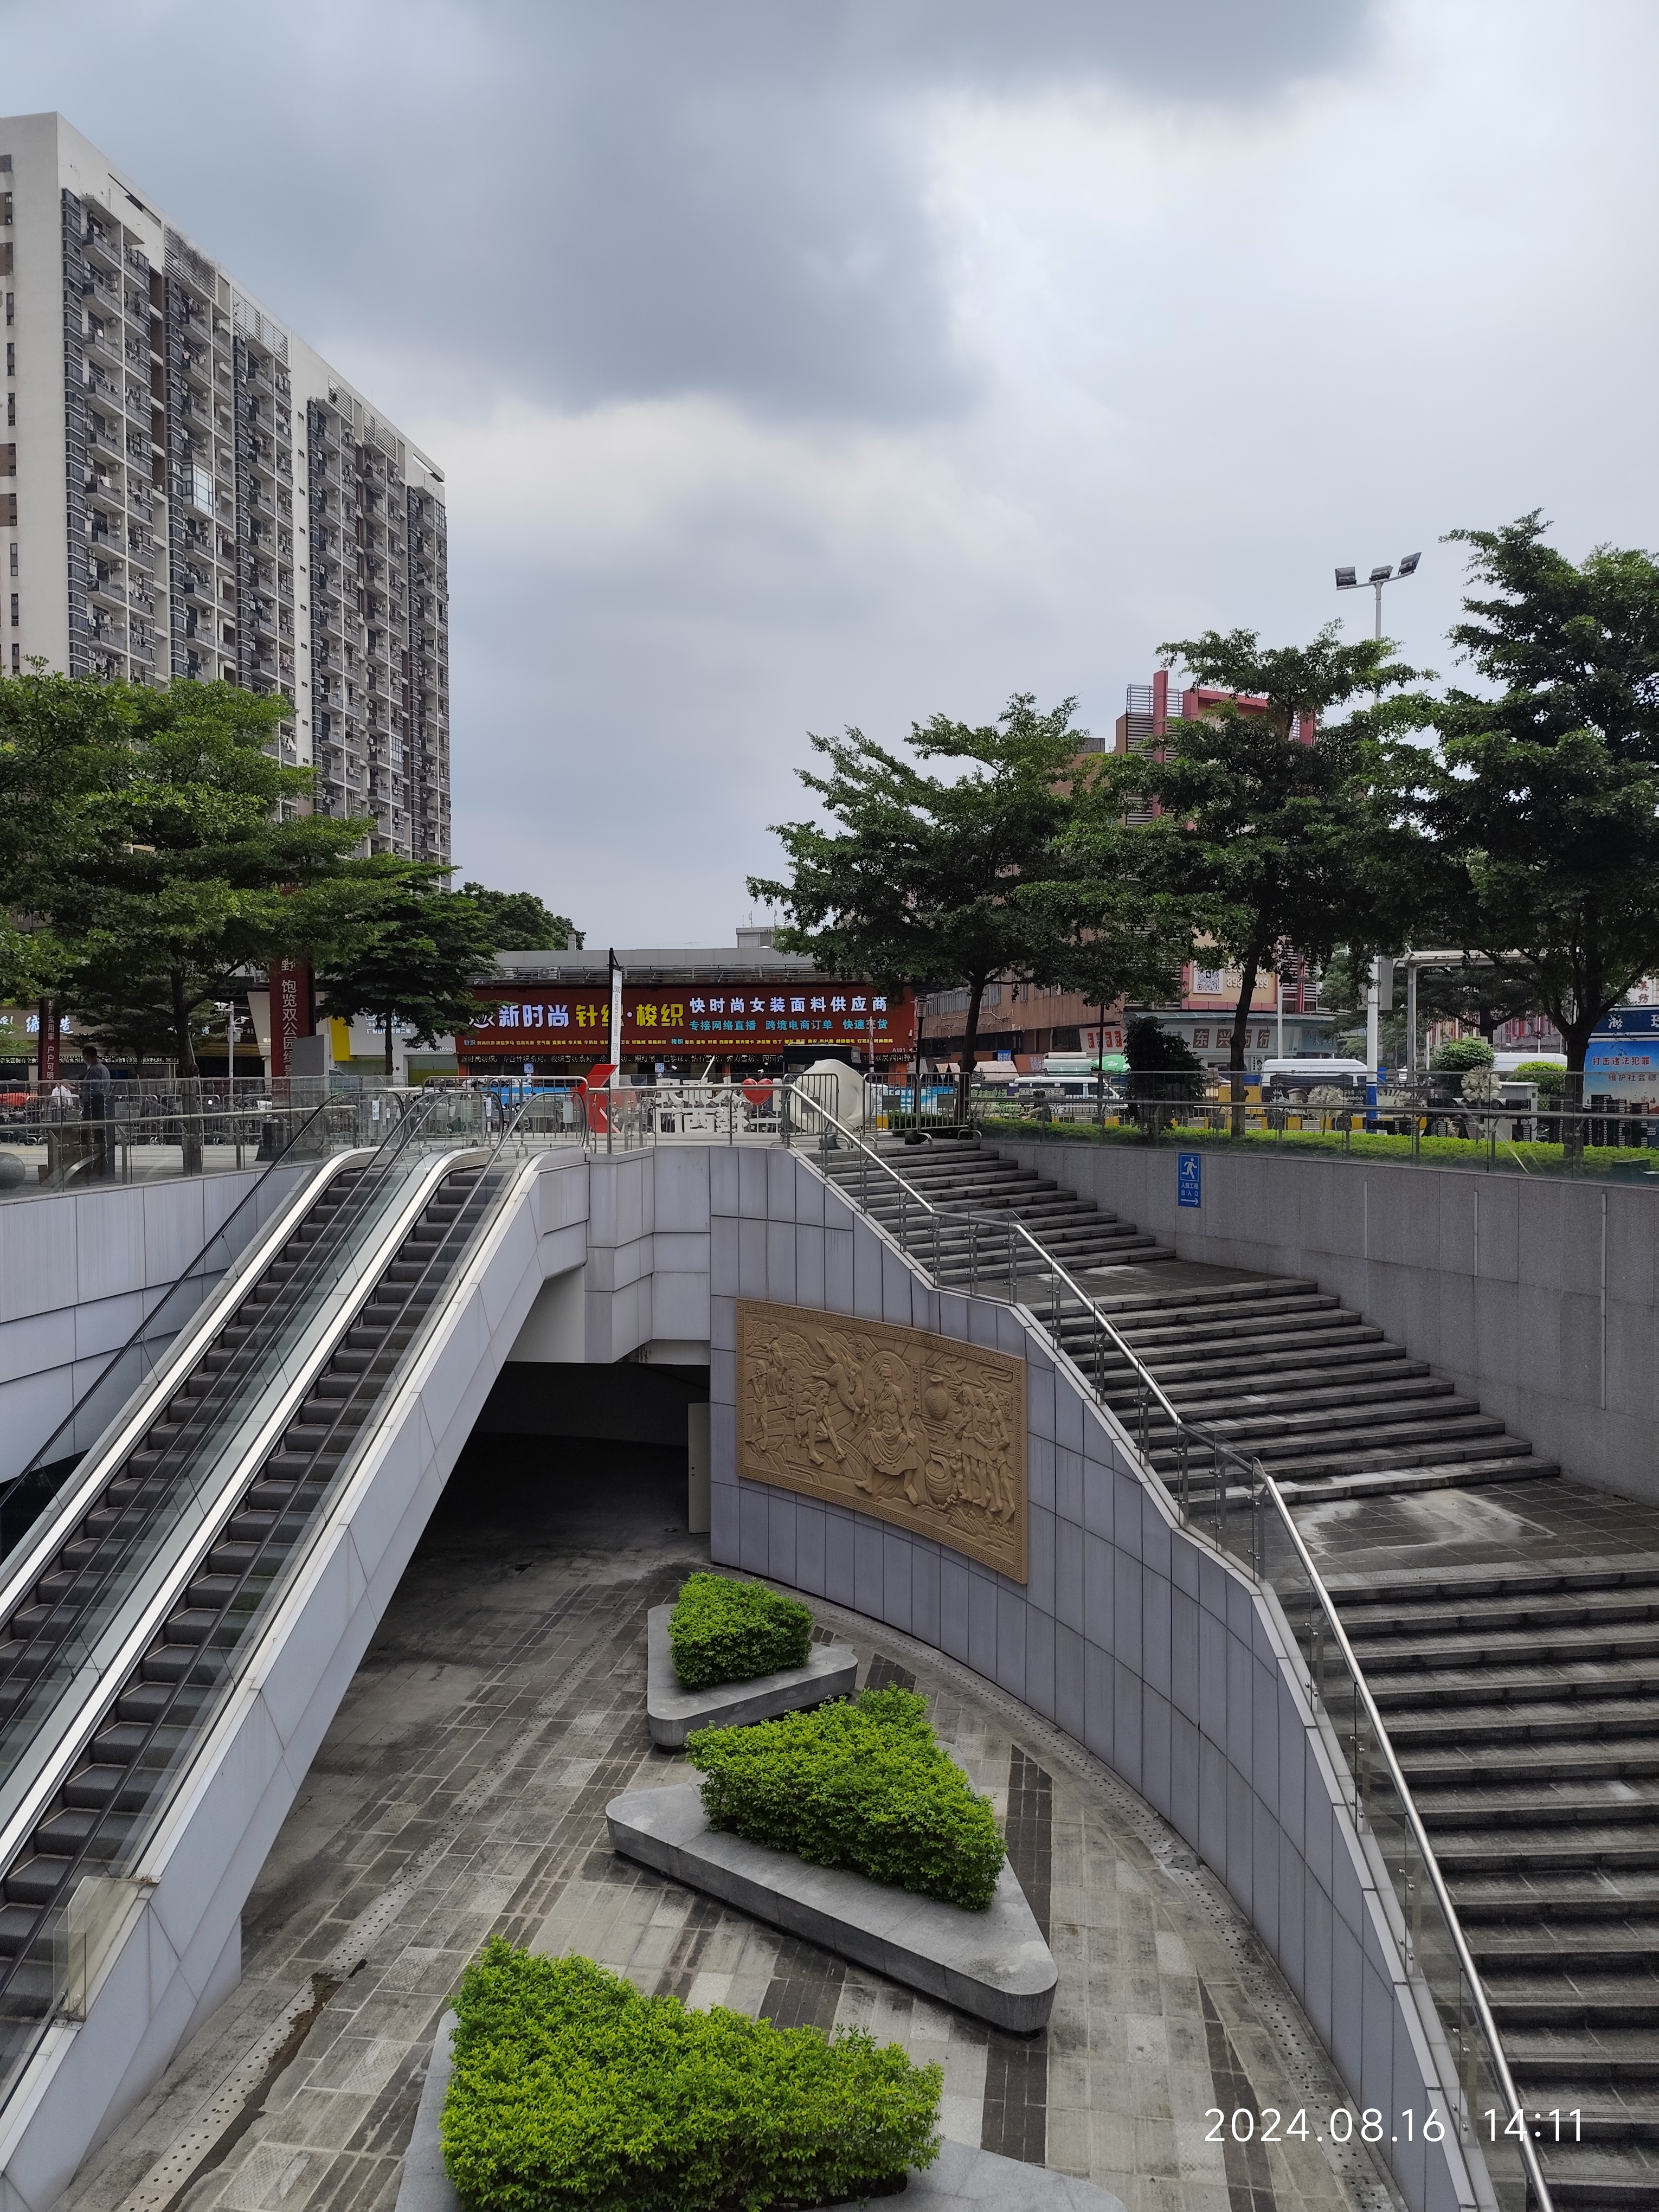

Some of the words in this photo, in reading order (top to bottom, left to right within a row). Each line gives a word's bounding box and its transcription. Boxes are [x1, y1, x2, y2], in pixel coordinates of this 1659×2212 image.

[689, 996, 887, 1014] 快时尚女装面料供应商
[498, 1004, 569, 1028] 新时尚
[689, 1020, 756, 1031] 专接网络直播
[766, 1020, 833, 1030] 跨境电商订单
[1593, 1057, 1649, 1065] 打击违法犯罪
